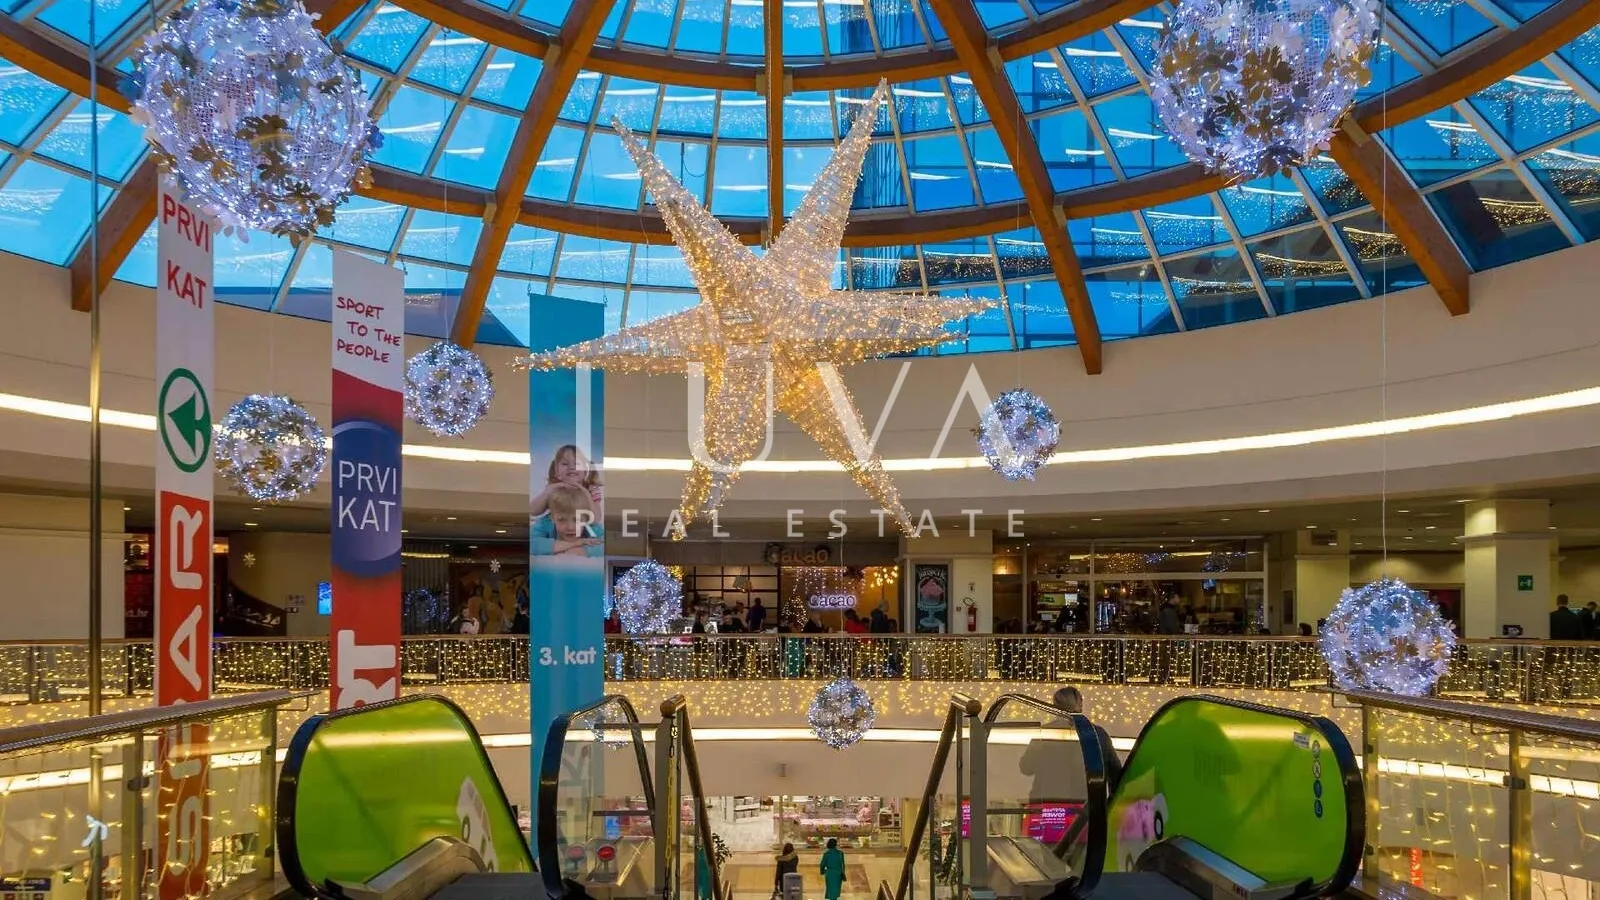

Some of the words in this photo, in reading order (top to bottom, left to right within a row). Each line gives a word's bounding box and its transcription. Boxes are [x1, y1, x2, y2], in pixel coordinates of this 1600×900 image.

[163, 192, 209, 253] PRVI
[167, 259, 206, 309] KAT
[336, 297, 384, 320] SPORT
[346, 321, 368, 337] TO
[374, 328, 401, 346] THE
[337, 339, 390, 364] PEOPLE
[338, 461, 397, 495] PRVI
[338, 500, 396, 532] KAT
[539, 647, 558, 665] 3.
[564, 646, 596, 665] kat
